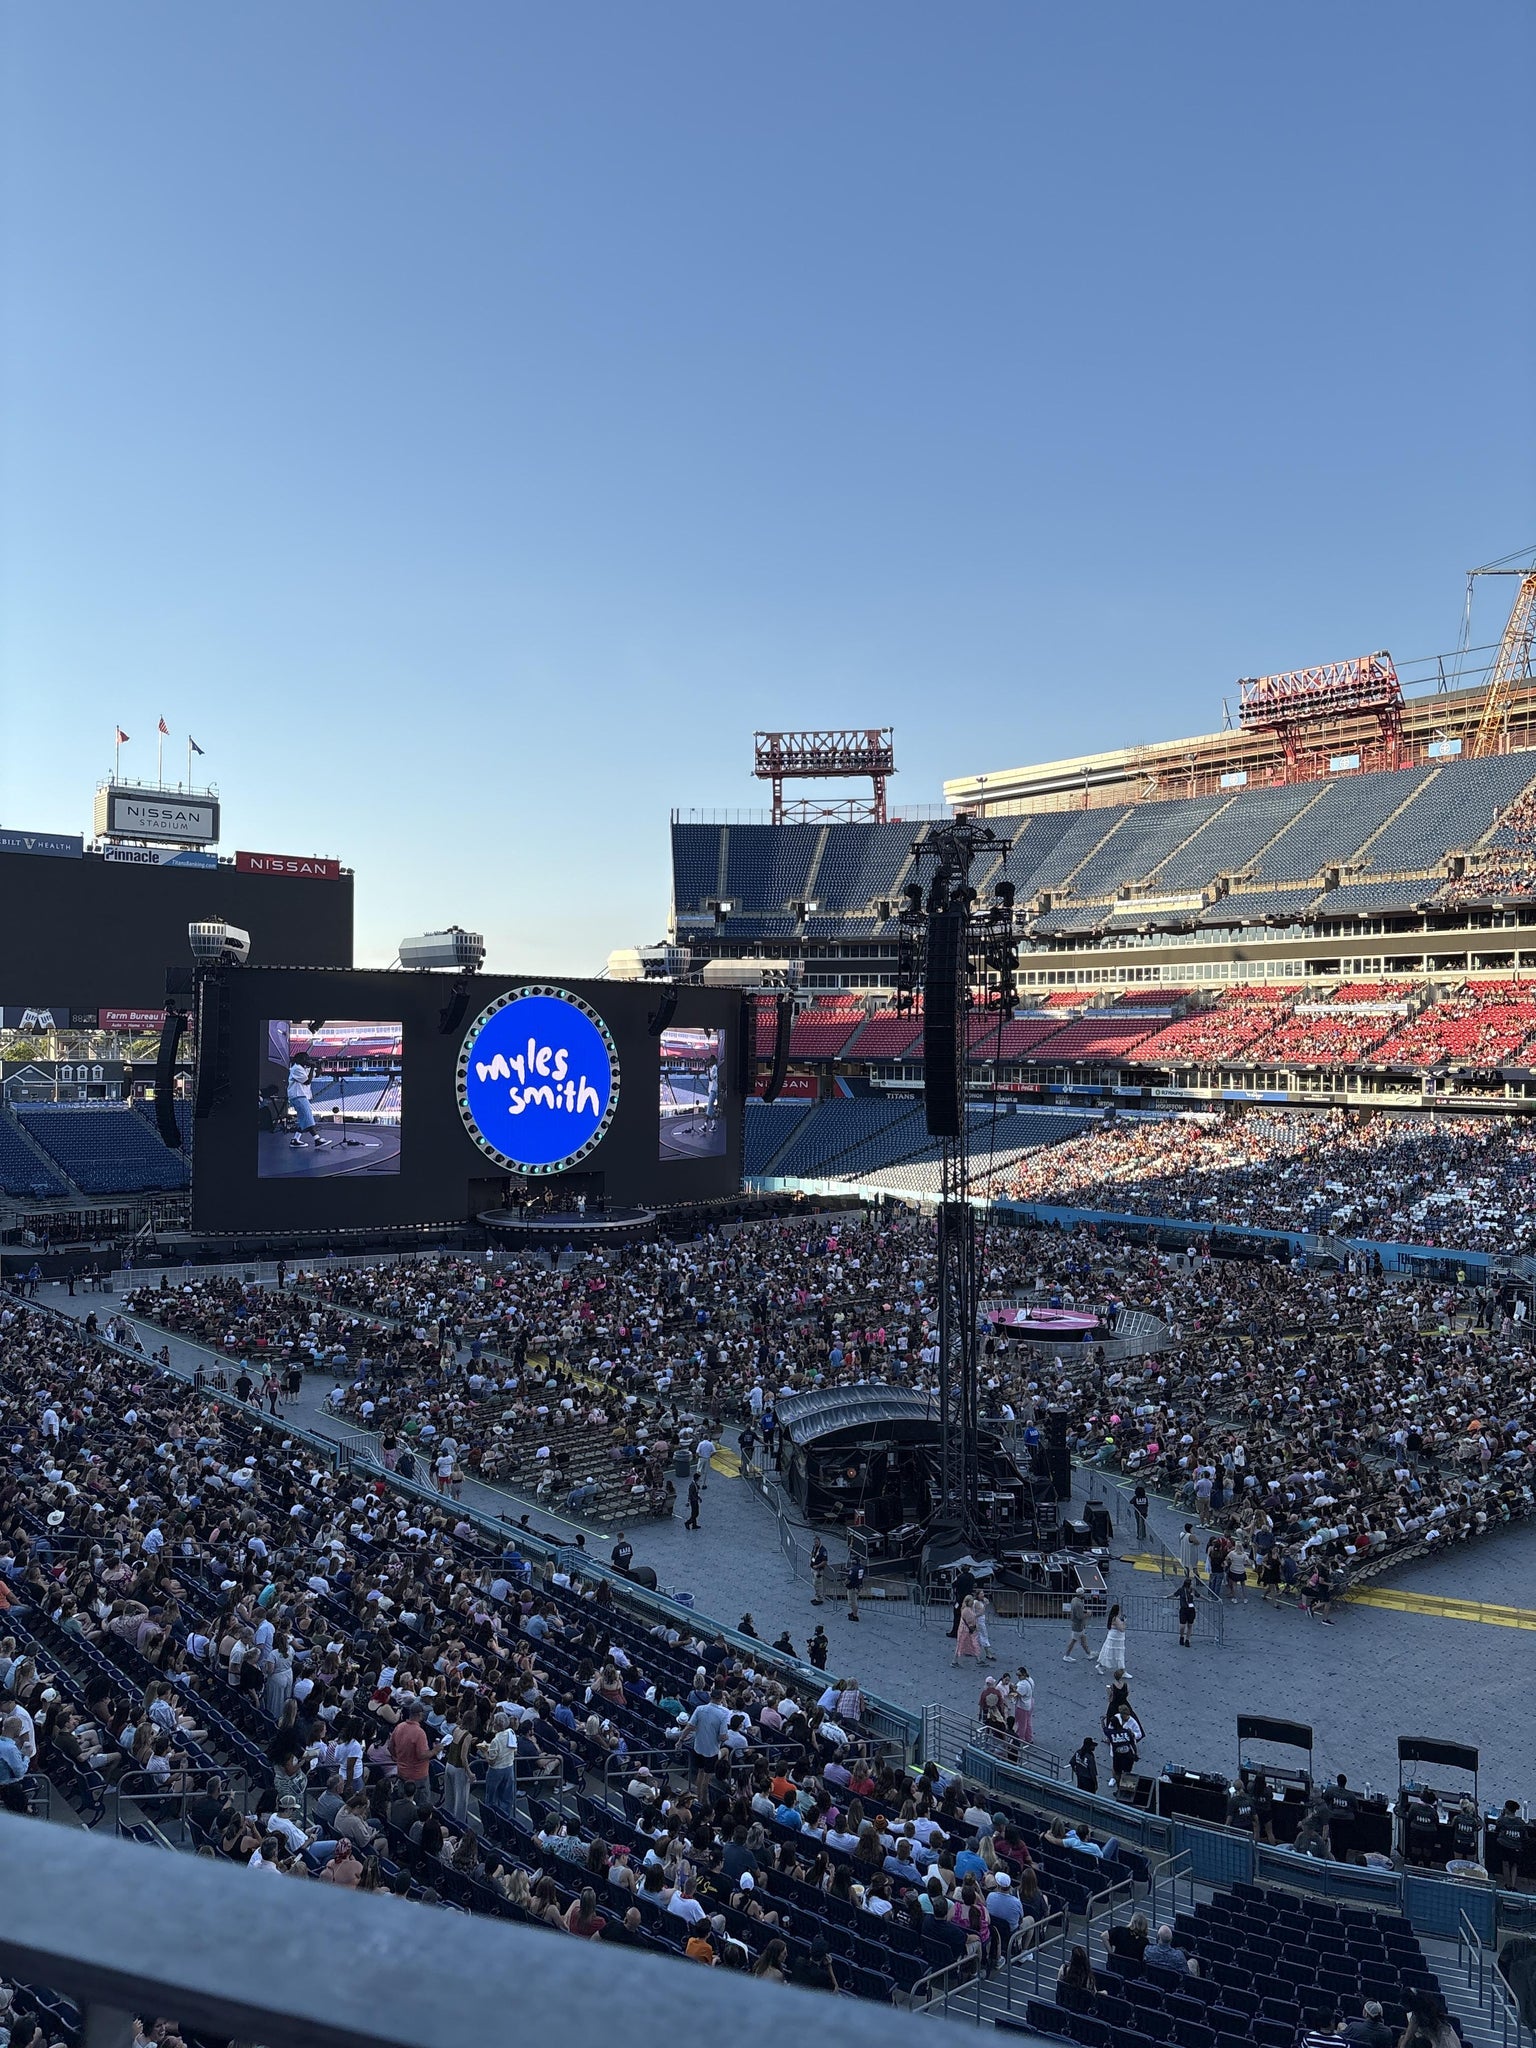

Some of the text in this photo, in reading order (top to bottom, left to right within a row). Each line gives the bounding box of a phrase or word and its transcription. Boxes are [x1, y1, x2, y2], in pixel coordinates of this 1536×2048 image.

[128, 806, 200, 822] NISSAN
[139, 819, 188, 830] STADIUM
[0, 838, 21, 846] BILT
[38, 842, 71, 850] HEALTH
[105, 847, 160, 864] Pinnacle
[250, 858, 327, 875] NISSAN
[106, 1012, 128, 1020] Farm
[130, 1012, 159, 1020] Bureau
[476, 1038, 568, 1085] myles
[754, 1080, 809, 1088] NISAN
[508, 1075, 599, 1117] smith
